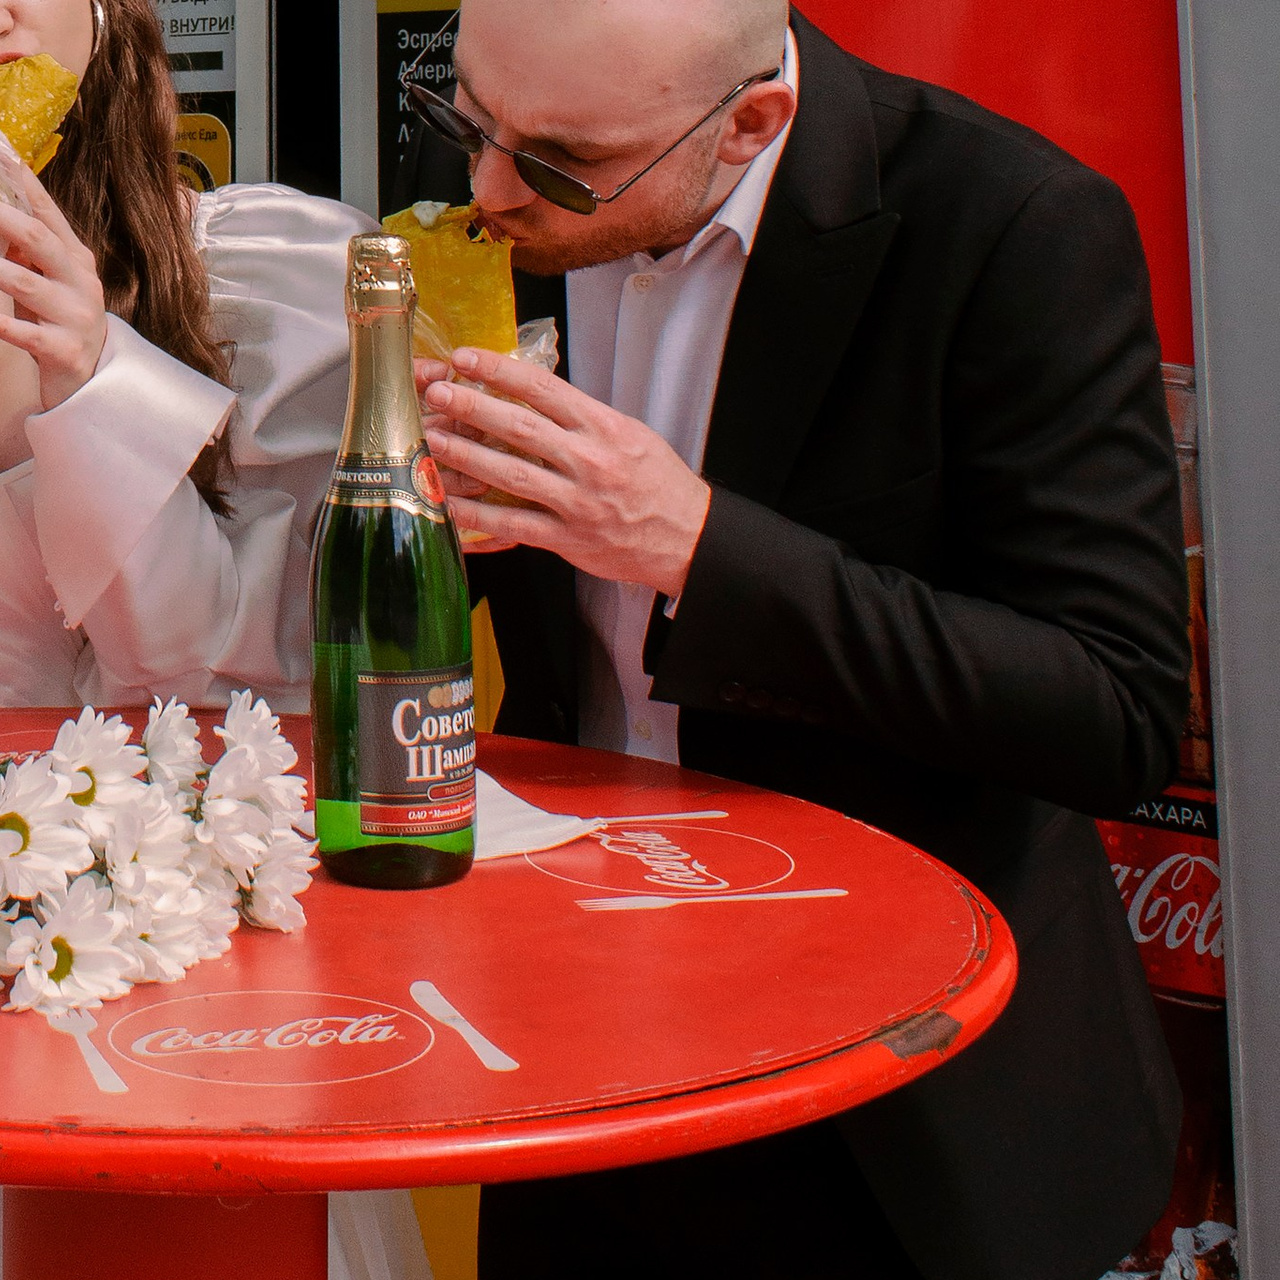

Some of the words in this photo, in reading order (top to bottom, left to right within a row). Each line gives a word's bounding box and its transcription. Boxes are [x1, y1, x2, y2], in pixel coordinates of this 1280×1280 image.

[170, 16, 235, 34] ВНУТРИ!
[398, 60, 456, 83] Амери
[199, 129, 218, 141] Еда
[1129, 801, 1207, 829] АХАРА
[131, 1014, 399, 1057] Coca-Cola
